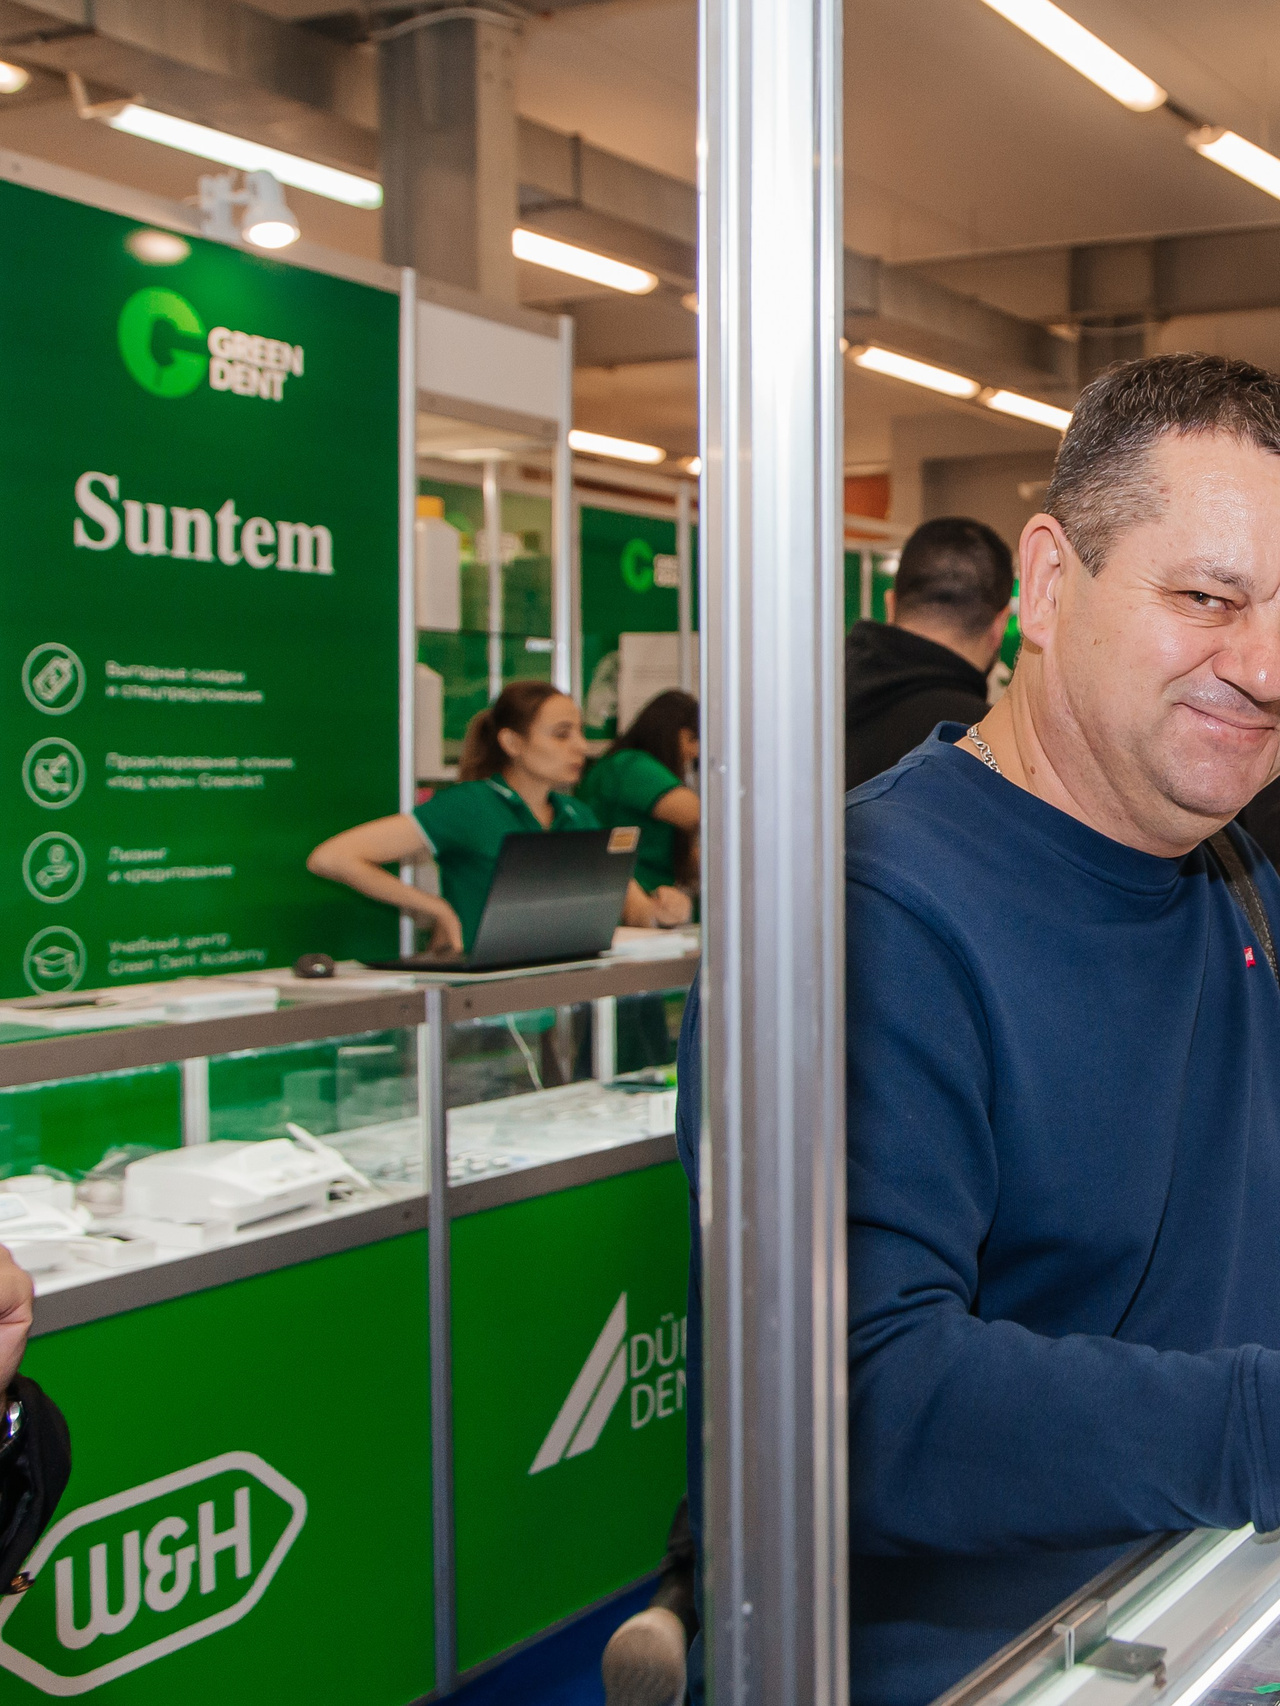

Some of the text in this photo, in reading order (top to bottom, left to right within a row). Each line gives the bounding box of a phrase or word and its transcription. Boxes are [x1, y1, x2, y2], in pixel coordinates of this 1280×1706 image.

[208, 326, 304, 377] GREEN
[209, 356, 287, 401] DENT
[73, 471, 335, 575] Suntem
[108, 847, 169, 863] Лизинг
[124, 865, 234, 886] кредитование
[108, 932, 230, 954] Учебный центр
[108, 948, 267, 977] Green Dent Academy
[630, 1312, 687, 1378] DÜ
[55, 1487, 251, 1650] W&H
